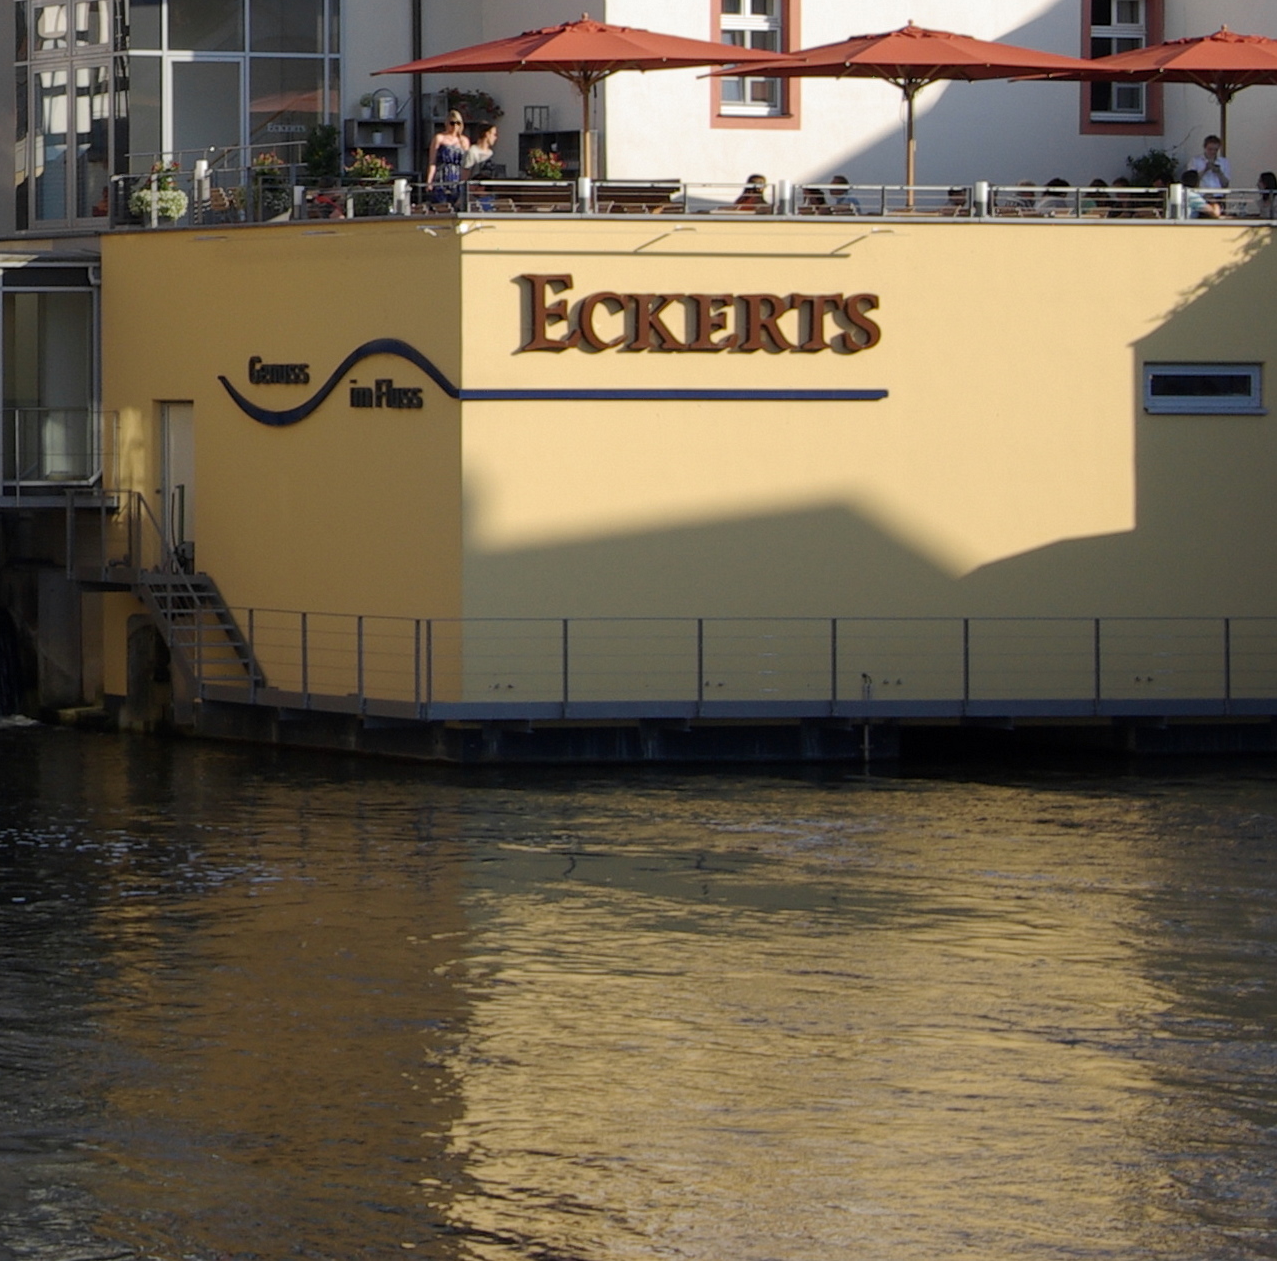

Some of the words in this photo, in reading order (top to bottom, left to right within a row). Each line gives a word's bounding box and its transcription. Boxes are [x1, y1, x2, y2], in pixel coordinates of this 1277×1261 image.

[517, 273, 881, 353] ECKERTS
[249, 356, 310, 384] Genuss
[375, 379, 423, 409] Fluss
